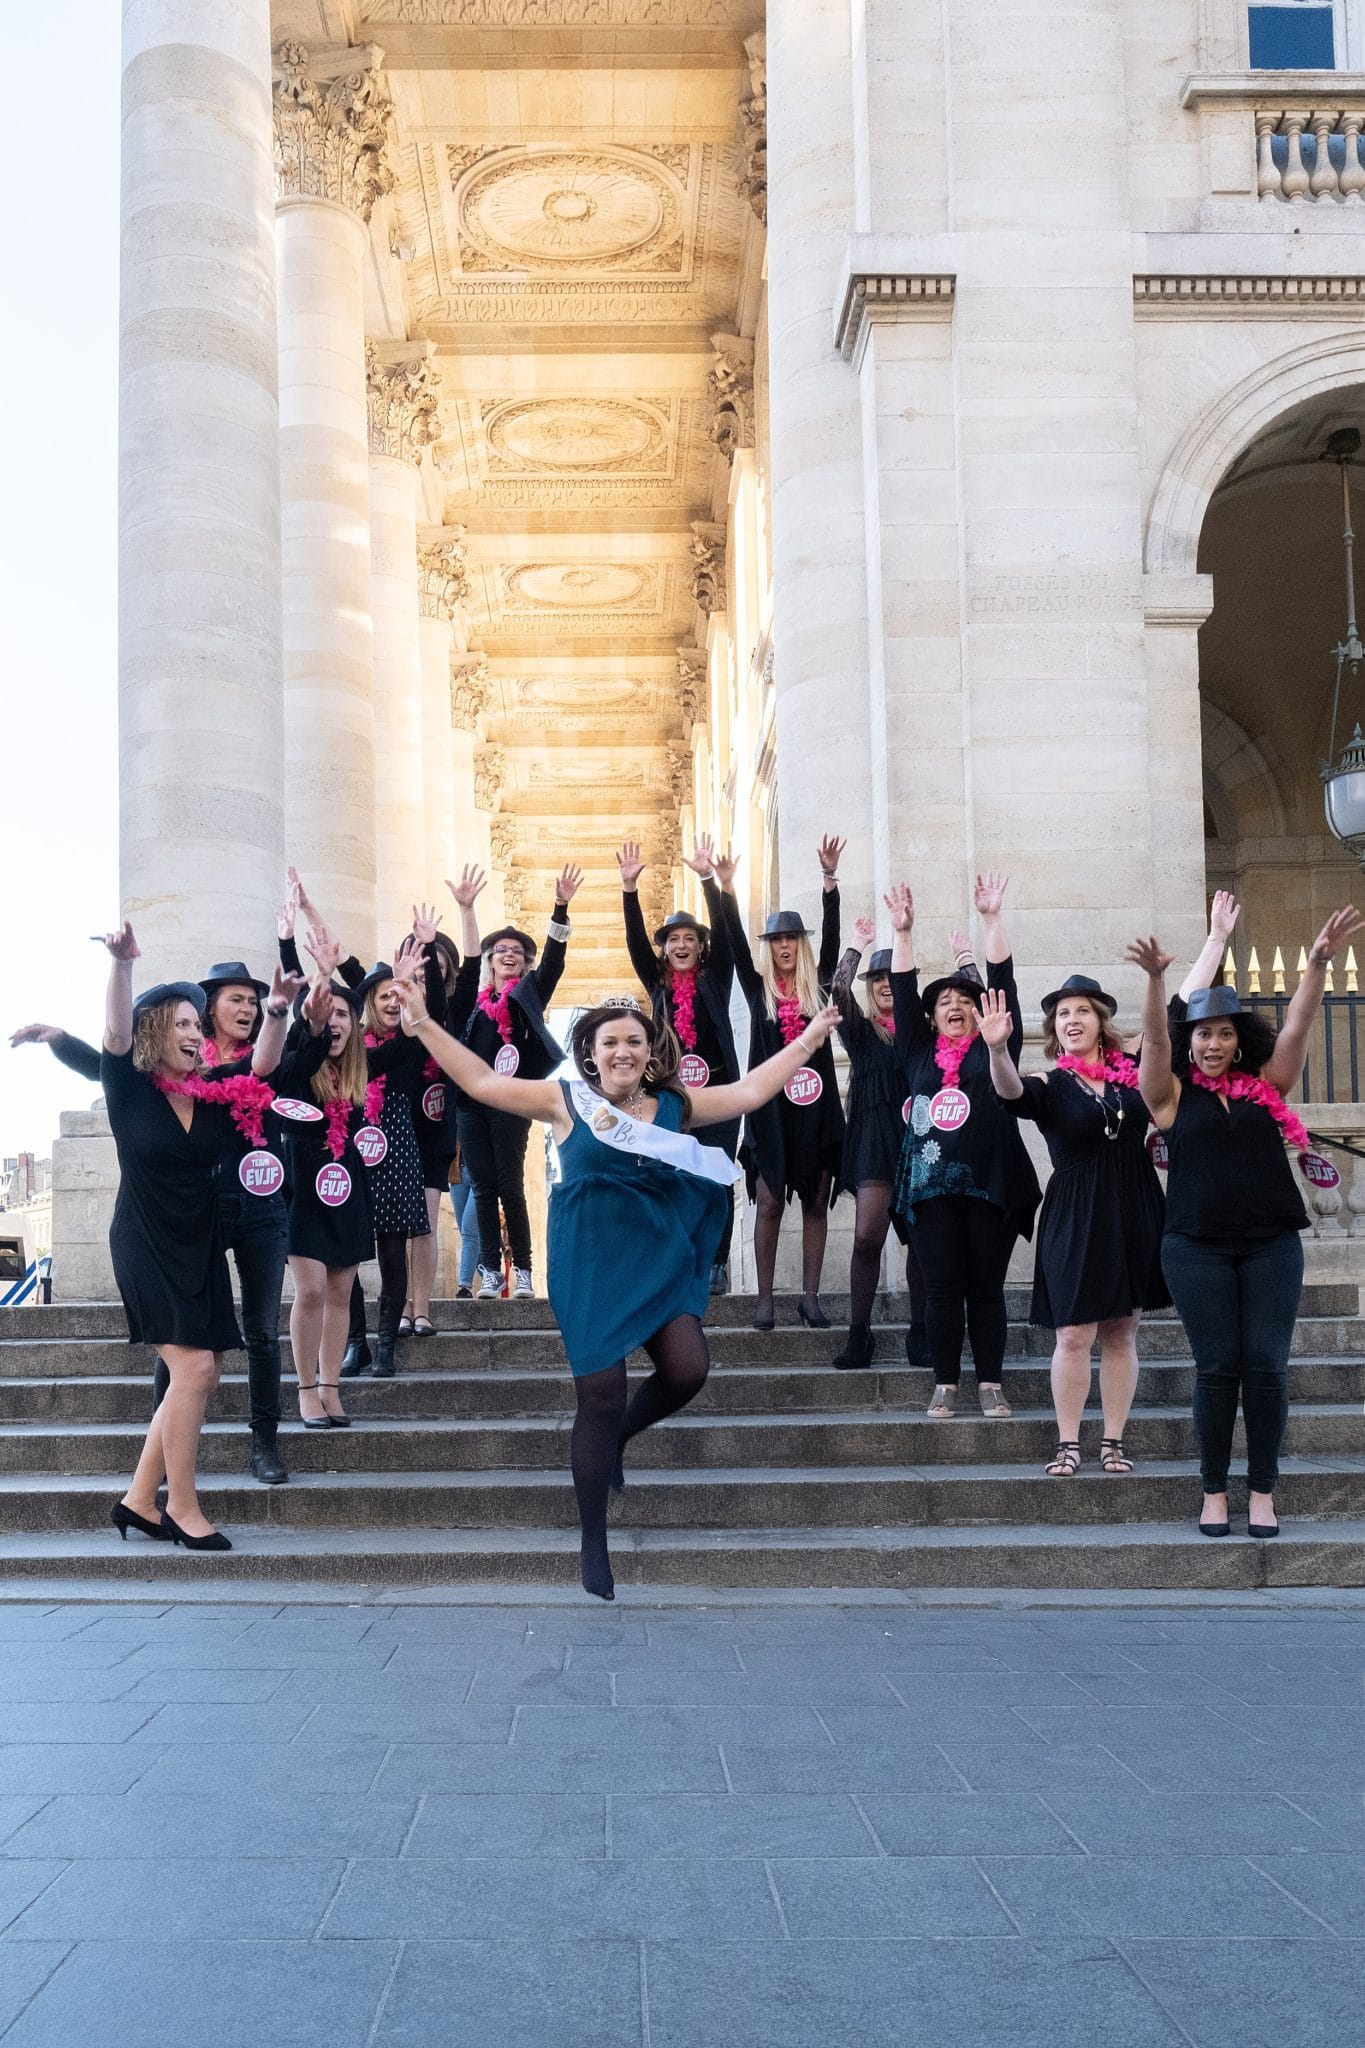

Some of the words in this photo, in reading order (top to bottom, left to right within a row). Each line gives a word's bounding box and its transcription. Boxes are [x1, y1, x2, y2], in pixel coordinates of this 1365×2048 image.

[971, 595, 1070, 612] CHAPEAU
[1076, 595, 1144, 611] ROUGE
[497, 1056, 516, 1074] EVJF
[793, 1072, 809, 1083] TEAM
[790, 1078, 818, 1101] EVJF
[428, 1096, 445, 1116] EVJ
[942, 1096, 959, 1104] TEAM
[934, 1104, 966, 1122] EVJF
[364, 1133, 379, 1141] TEAM
[613, 1120, 638, 1145] Be
[357, 1141, 385, 1158] EVJF
[1151, 1145, 1169, 1163] EV
[252, 1158, 270, 1168] TEAM
[245, 1167, 279, 1187] EVJF
[327, 1170, 342, 1180] TEAM
[1305, 1163, 1335, 1181] EVJF
[321, 1180, 349, 1197] EVJF
